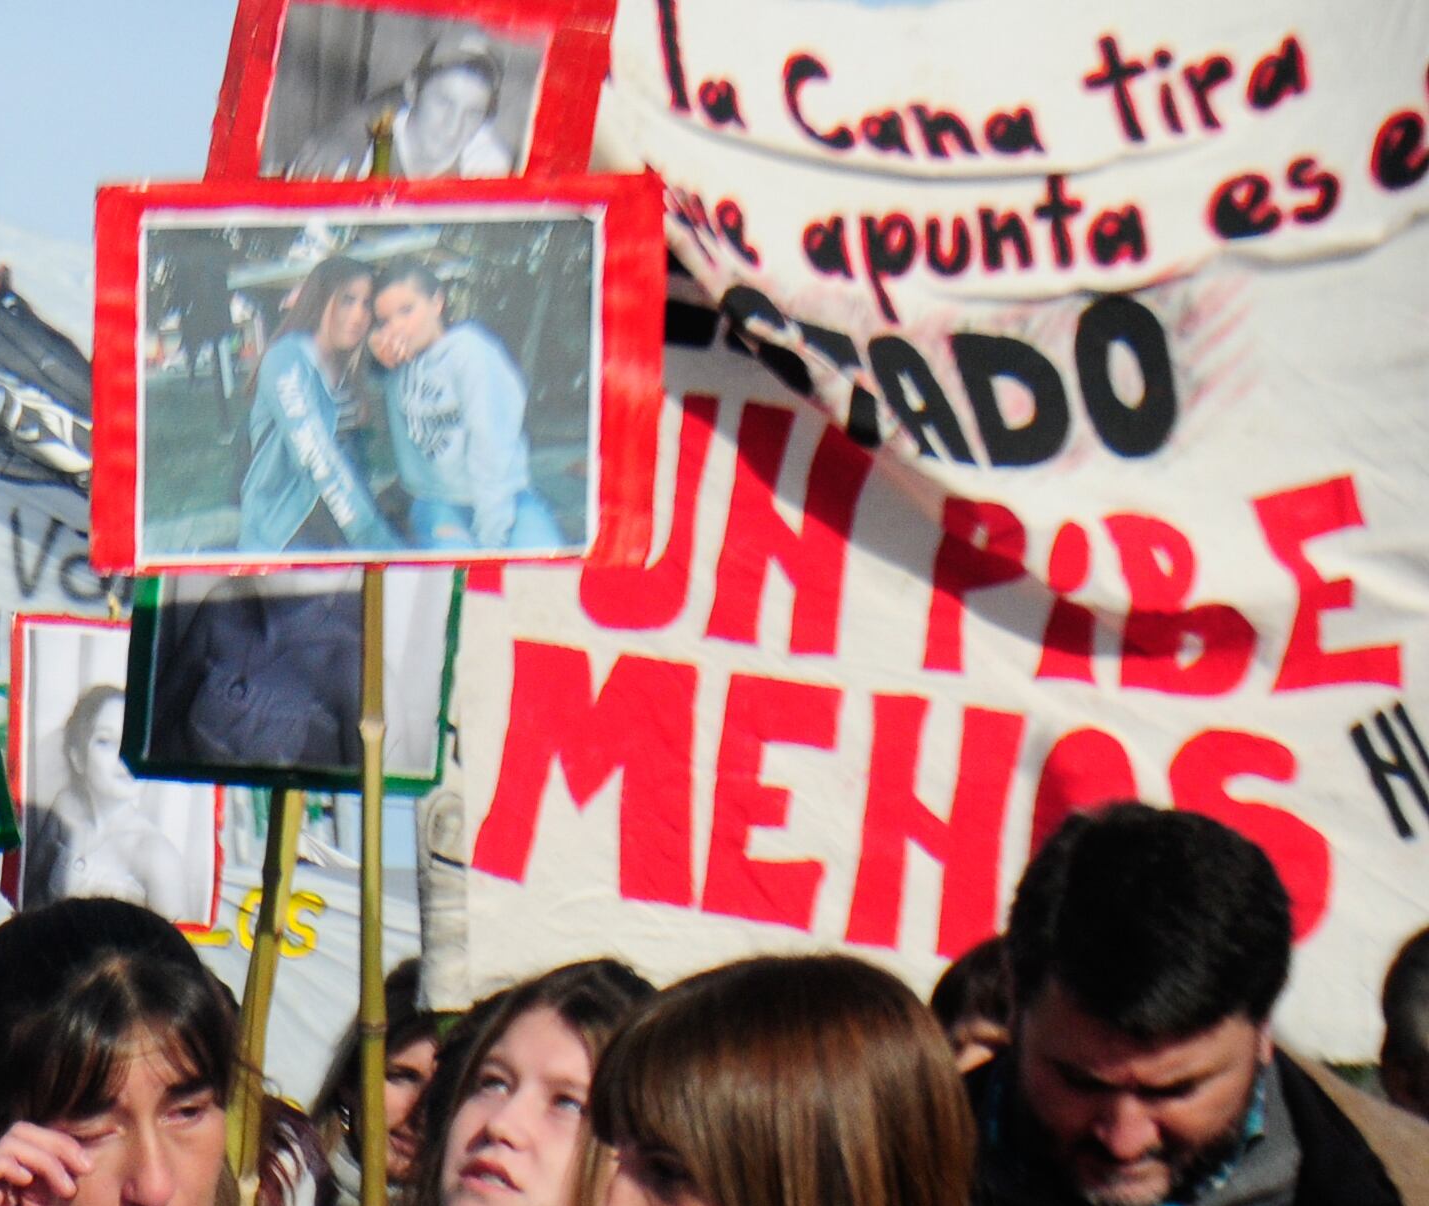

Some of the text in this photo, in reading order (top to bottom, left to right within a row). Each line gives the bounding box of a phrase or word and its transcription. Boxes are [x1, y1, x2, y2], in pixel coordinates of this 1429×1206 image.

[782, 53, 1046, 156] Cana
[1084, 33, 1309, 143] tira
[801, 172, 1149, 325] apunta
[1205, 156, 1341, 240] es
[1370, 75, 1429, 192] e
[664, 247, 1178, 469] STADO
[924, 474, 1404, 696] PIBE
